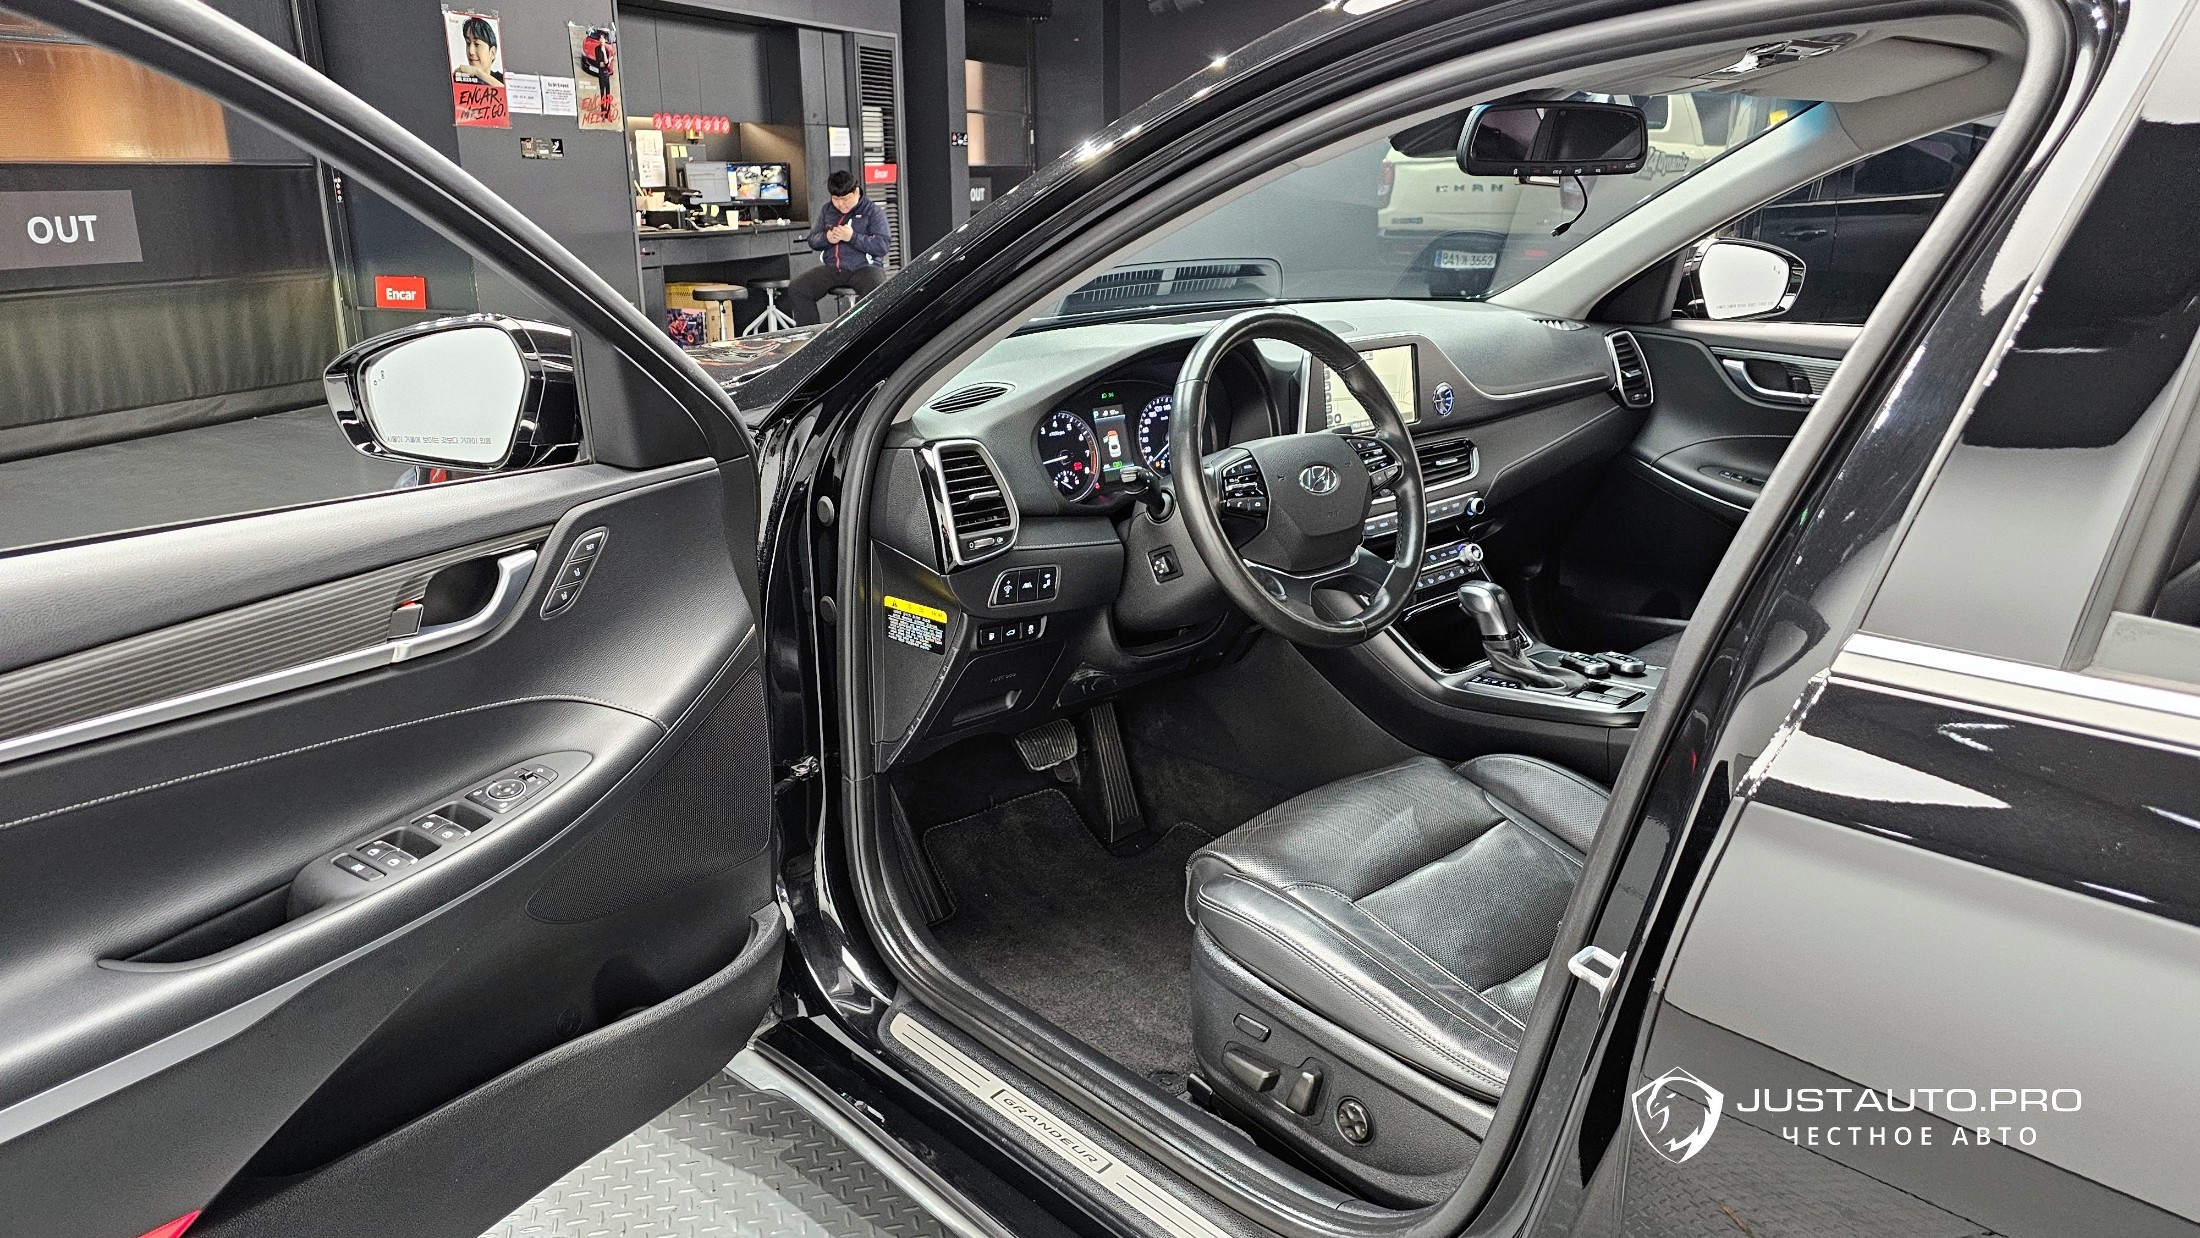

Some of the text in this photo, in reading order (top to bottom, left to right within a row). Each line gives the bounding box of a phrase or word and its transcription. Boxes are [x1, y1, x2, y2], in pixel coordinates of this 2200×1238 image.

[459, 87, 503, 106] ENCAR.
[969, 187, 985, 202] OUT
[1435, 183, 1504, 193] KHAN
[27, 214, 97, 245] OUT
[385, 287, 417, 301] Encar
[1003, 1098, 1098, 1163] GRANDEUR
